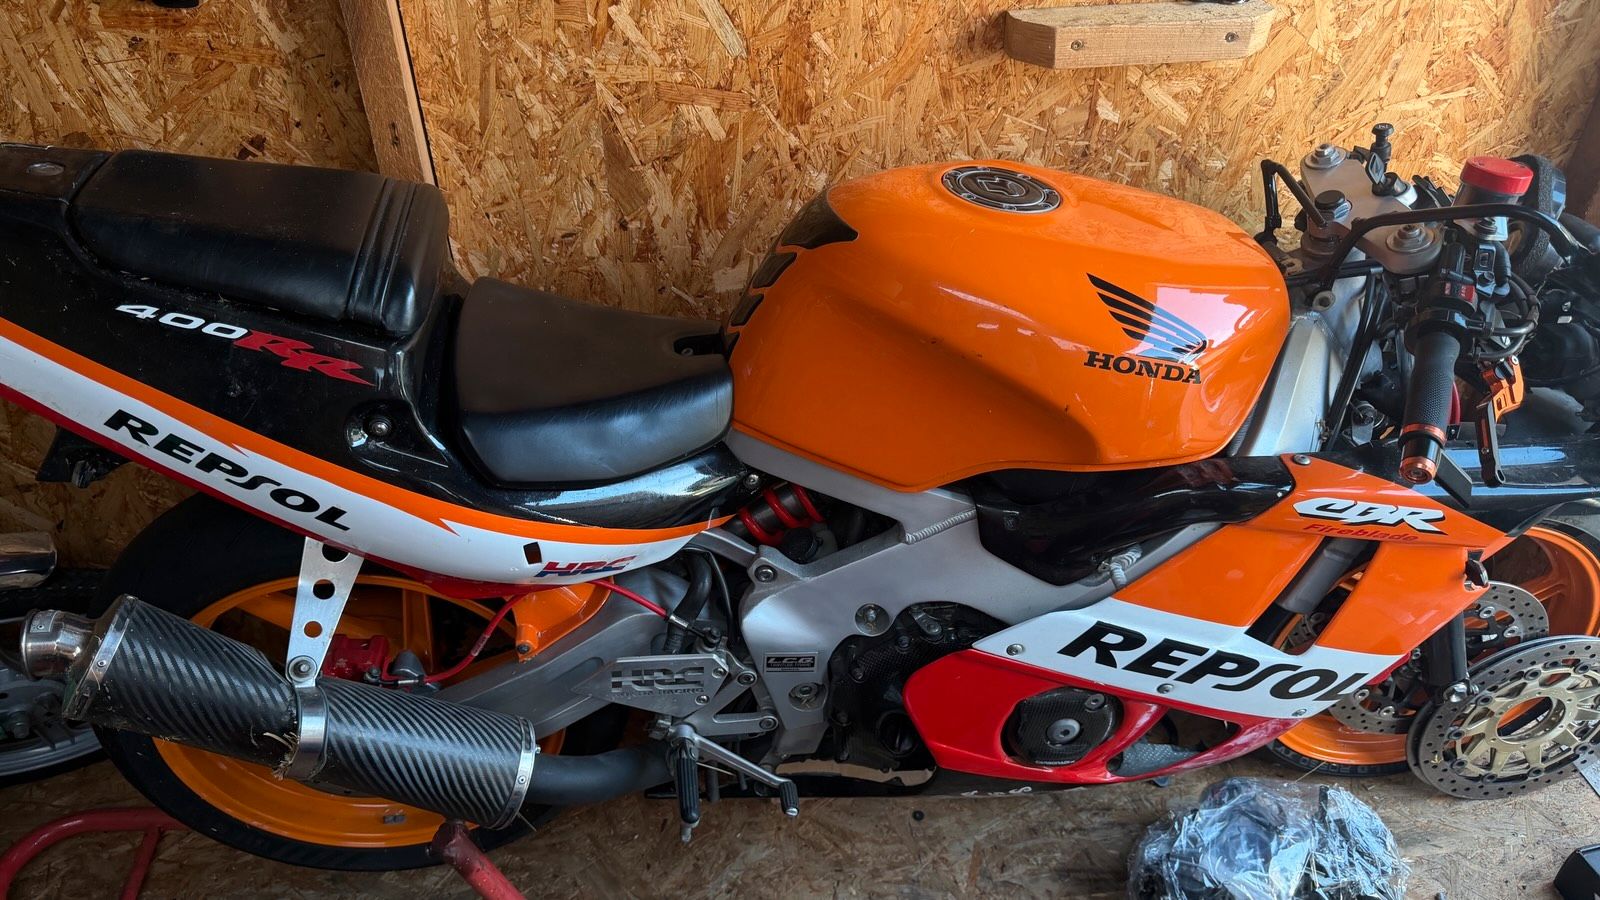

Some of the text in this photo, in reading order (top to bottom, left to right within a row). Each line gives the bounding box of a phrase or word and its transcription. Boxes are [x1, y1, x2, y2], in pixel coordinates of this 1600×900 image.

[1084, 350, 1202, 384] HONDA
[104, 409, 351, 531] REPSOL
[1292, 497, 1449, 536] CBR
[1303, 523, 1419, 542] Fireblade
[534, 555, 637, 577] HRC
[1057, 620, 1369, 701] REPSOL
